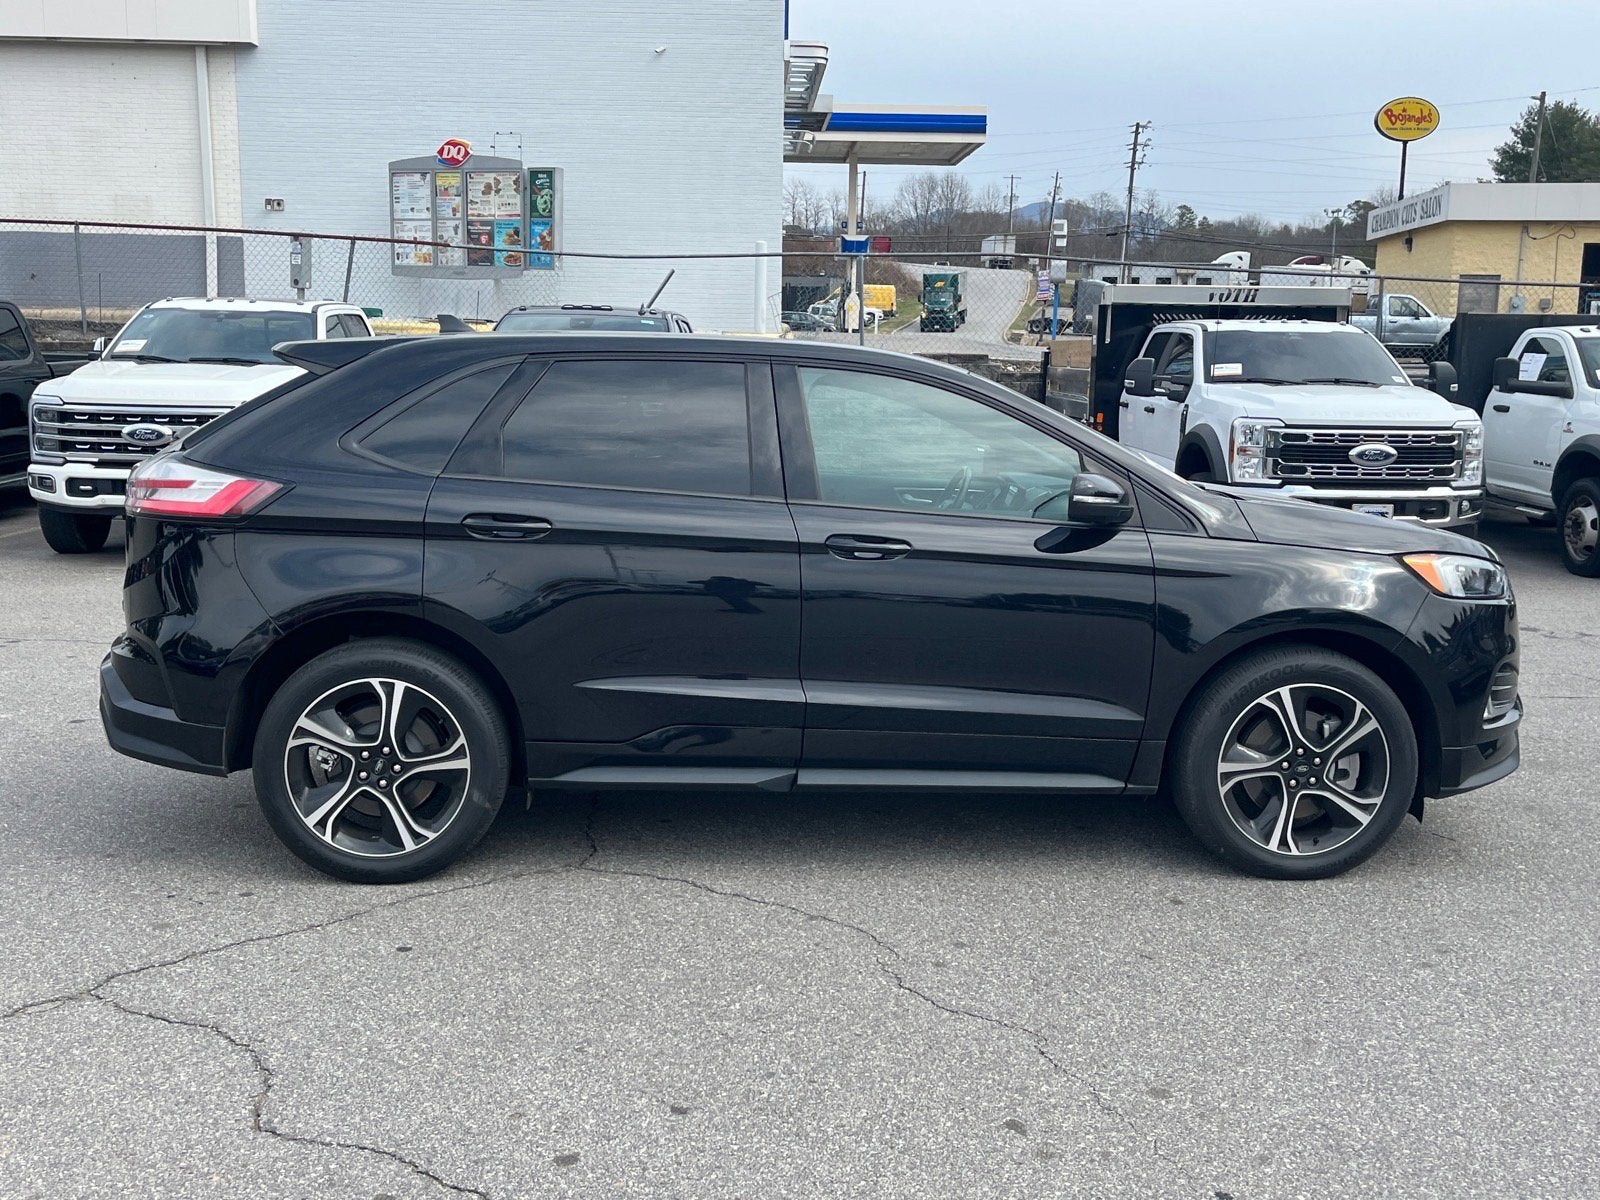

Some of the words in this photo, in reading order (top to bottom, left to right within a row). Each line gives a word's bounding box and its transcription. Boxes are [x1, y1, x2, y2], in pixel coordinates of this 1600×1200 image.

[442, 145, 466, 161] DQ
[1371, 207, 1400, 233] CHAMPION
[1402, 202, 1418, 226] CUTS
[1420, 194, 1443, 220] SALON
[133, 429, 158, 440] Ford
[1362, 450, 1387, 461] Ford
